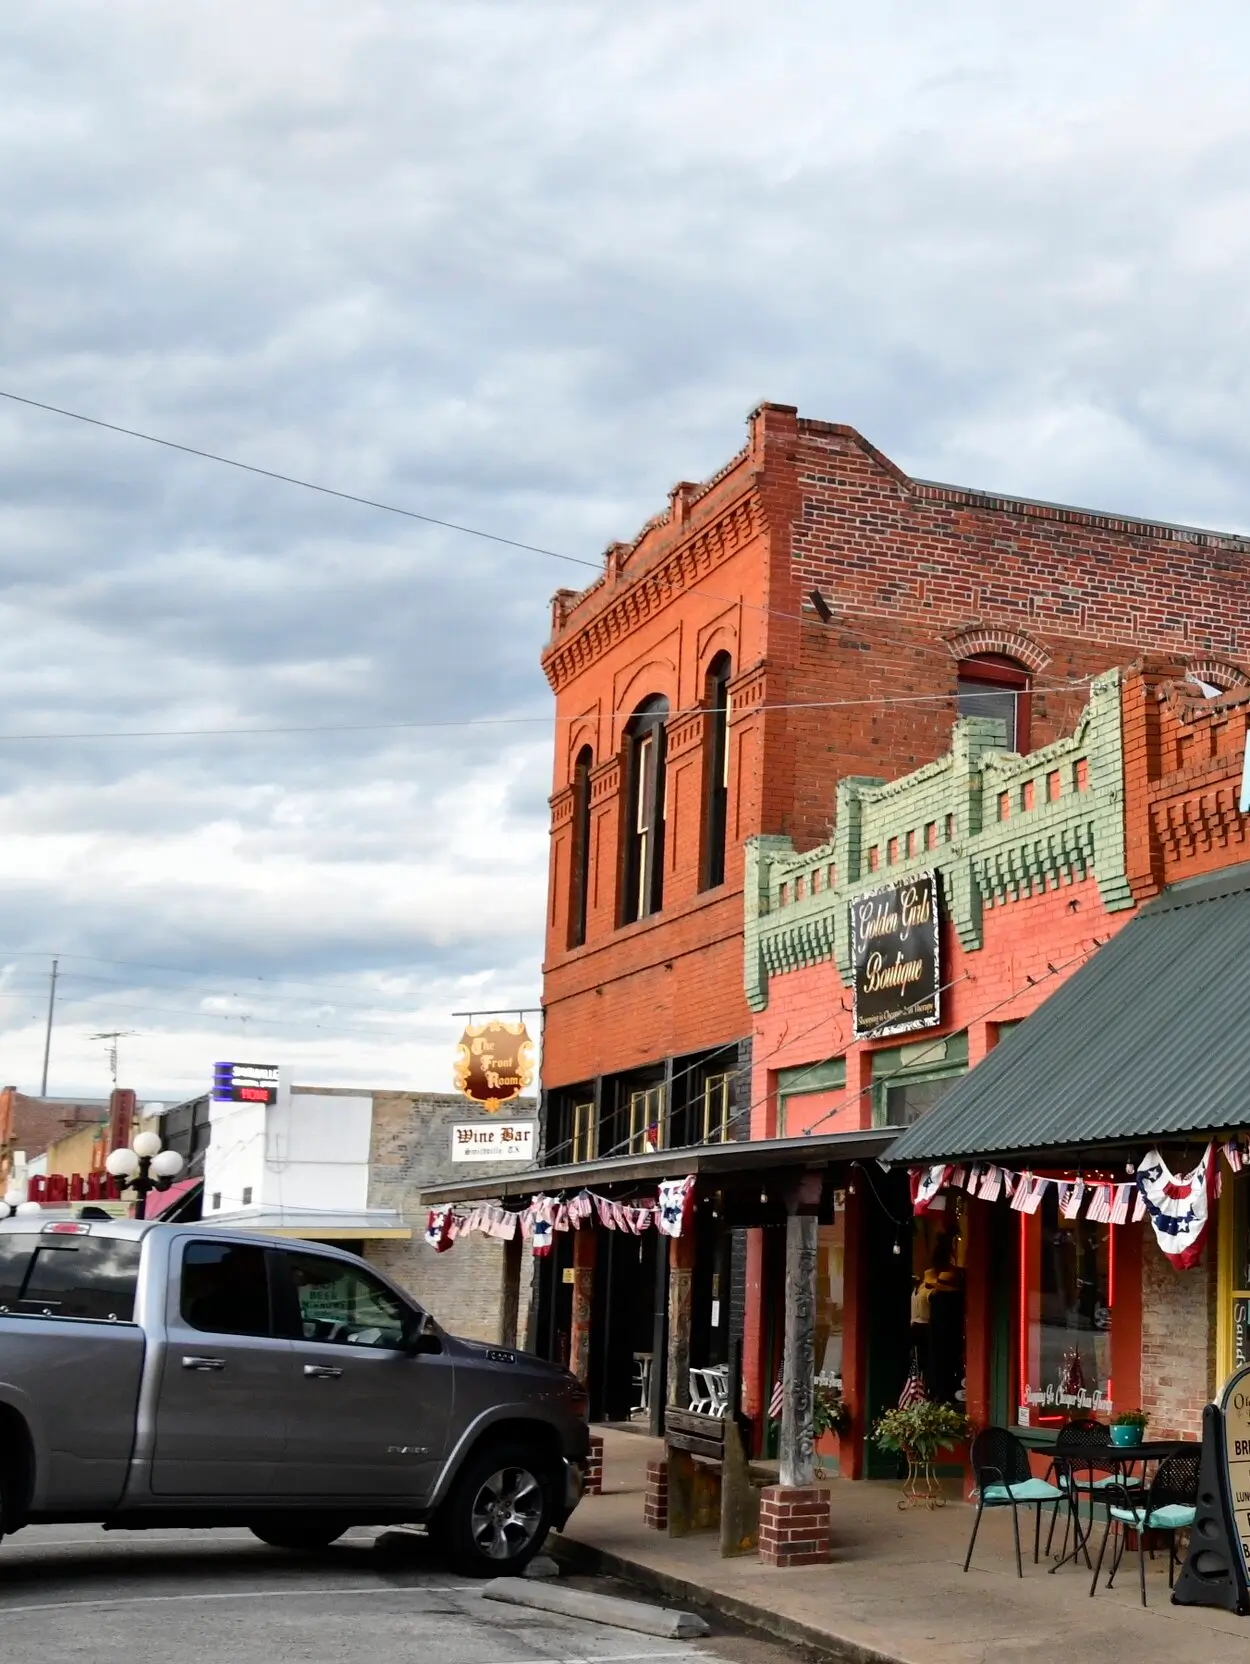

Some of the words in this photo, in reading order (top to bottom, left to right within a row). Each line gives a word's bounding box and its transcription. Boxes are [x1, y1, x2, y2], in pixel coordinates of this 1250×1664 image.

[858, 901, 898, 952] Golden
[900, 886, 930, 941] Girls
[863, 951, 923, 996] Boutique
[471, 1038, 494, 1055] The
[480, 1054, 512, 1071] Front
[485, 1071, 517, 1088] Room
[457, 1129, 494, 1143] Wine
[500, 1127, 530, 1143] Bar
